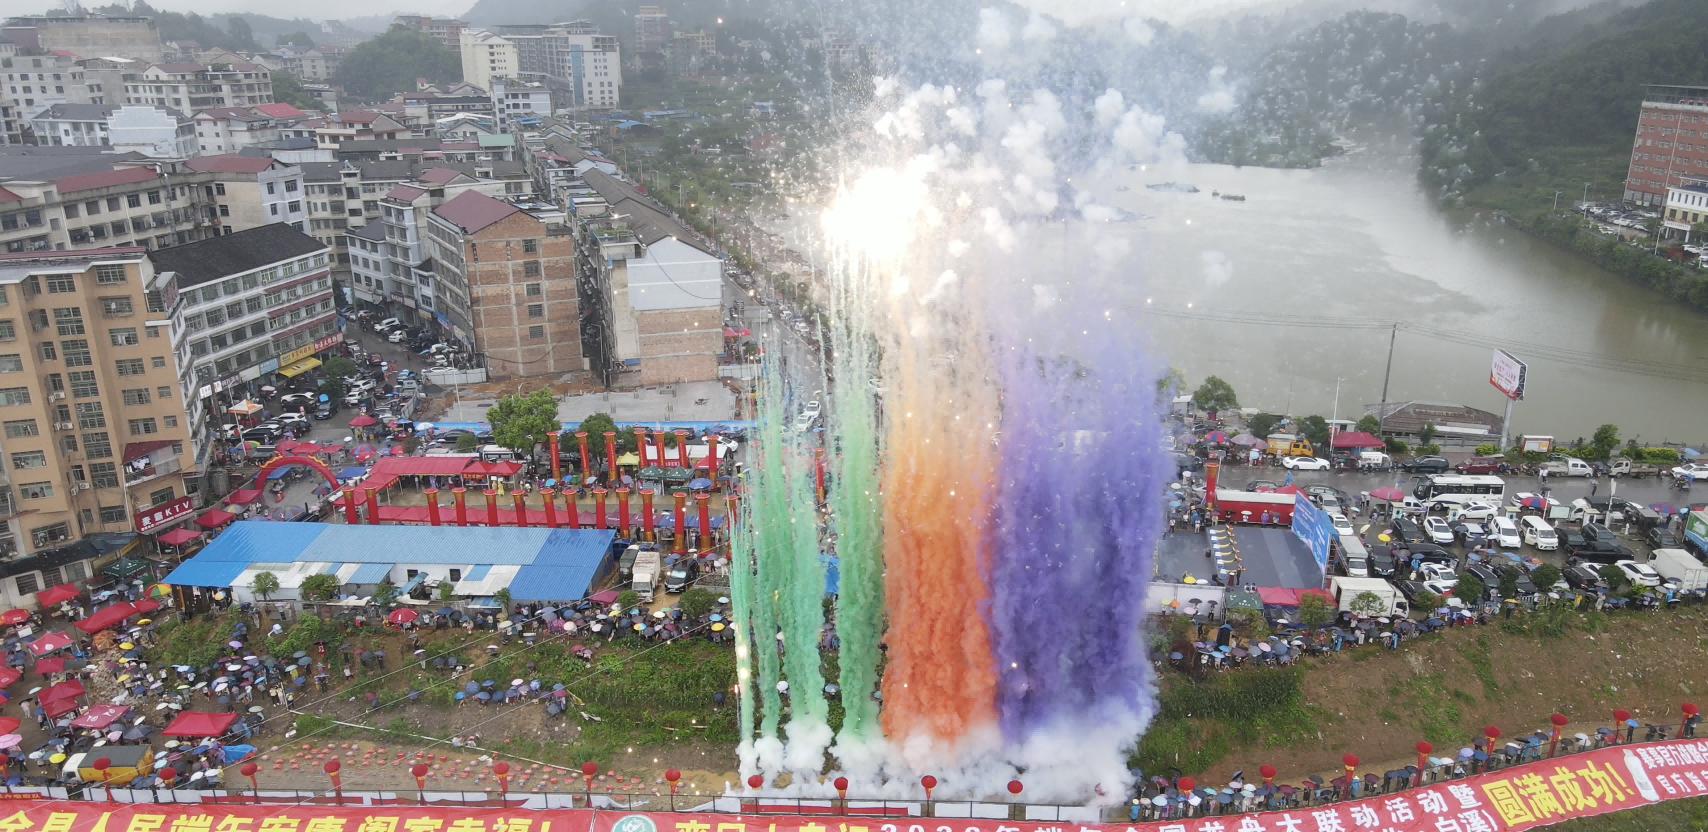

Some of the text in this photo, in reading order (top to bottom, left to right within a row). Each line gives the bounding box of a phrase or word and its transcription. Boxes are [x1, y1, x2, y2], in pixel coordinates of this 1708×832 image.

[1481, 760, 1636, 827] 圆满成功!
[1656, 770, 1708, 794] 官方指
